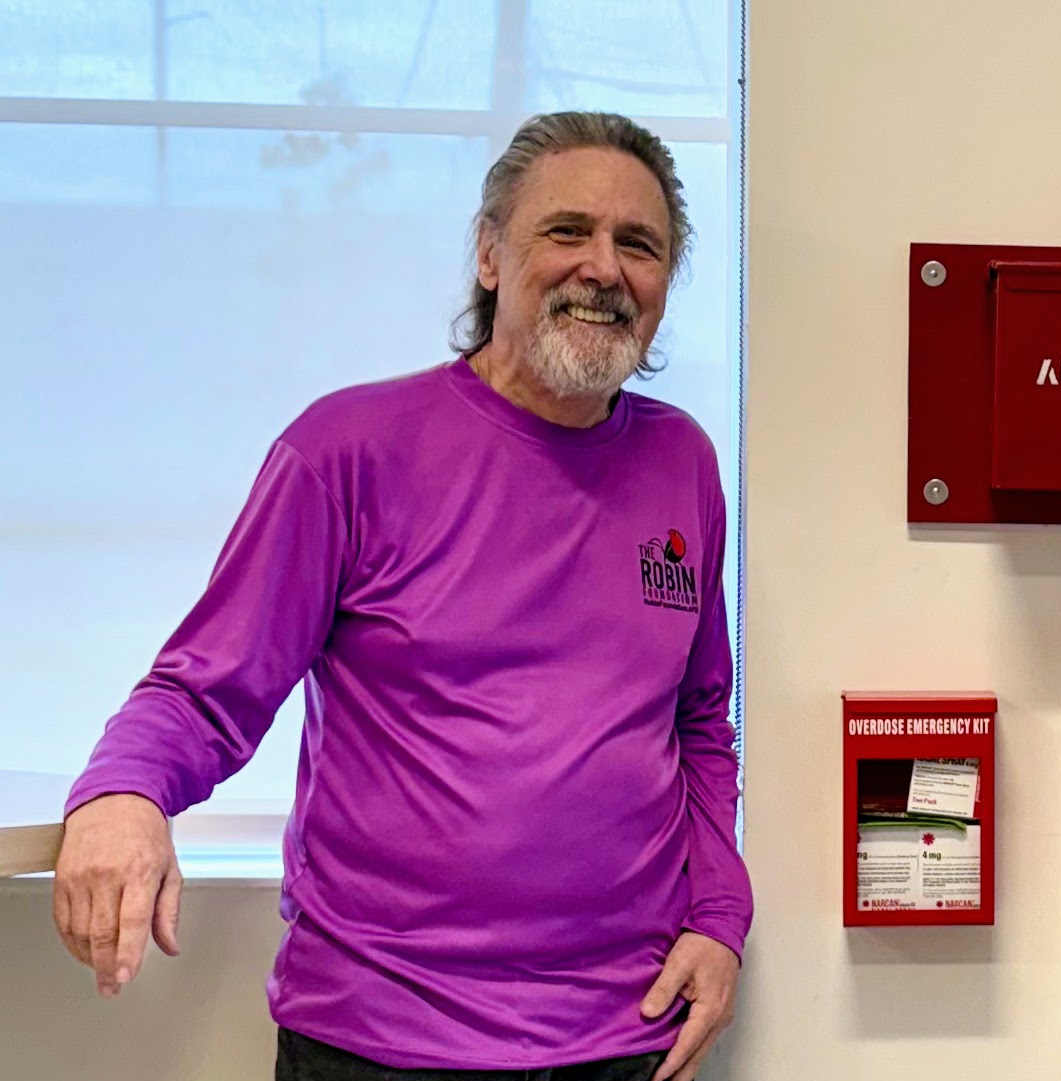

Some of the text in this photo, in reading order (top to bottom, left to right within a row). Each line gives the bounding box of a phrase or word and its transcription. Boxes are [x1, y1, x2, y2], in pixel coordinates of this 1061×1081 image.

[638, 544, 656, 561] THE
[640, 558, 697, 595] ROBIN
[642, 585, 699, 606] FOUNDATION
[848, 717, 990, 736] OVERDOSE EMERGENCY KIT
[922, 851, 928, 859] 4
[928, 853, 942, 861] mg
[871, 899, 899, 908] NARCAN
[945, 899, 973, 908] NARCAN
